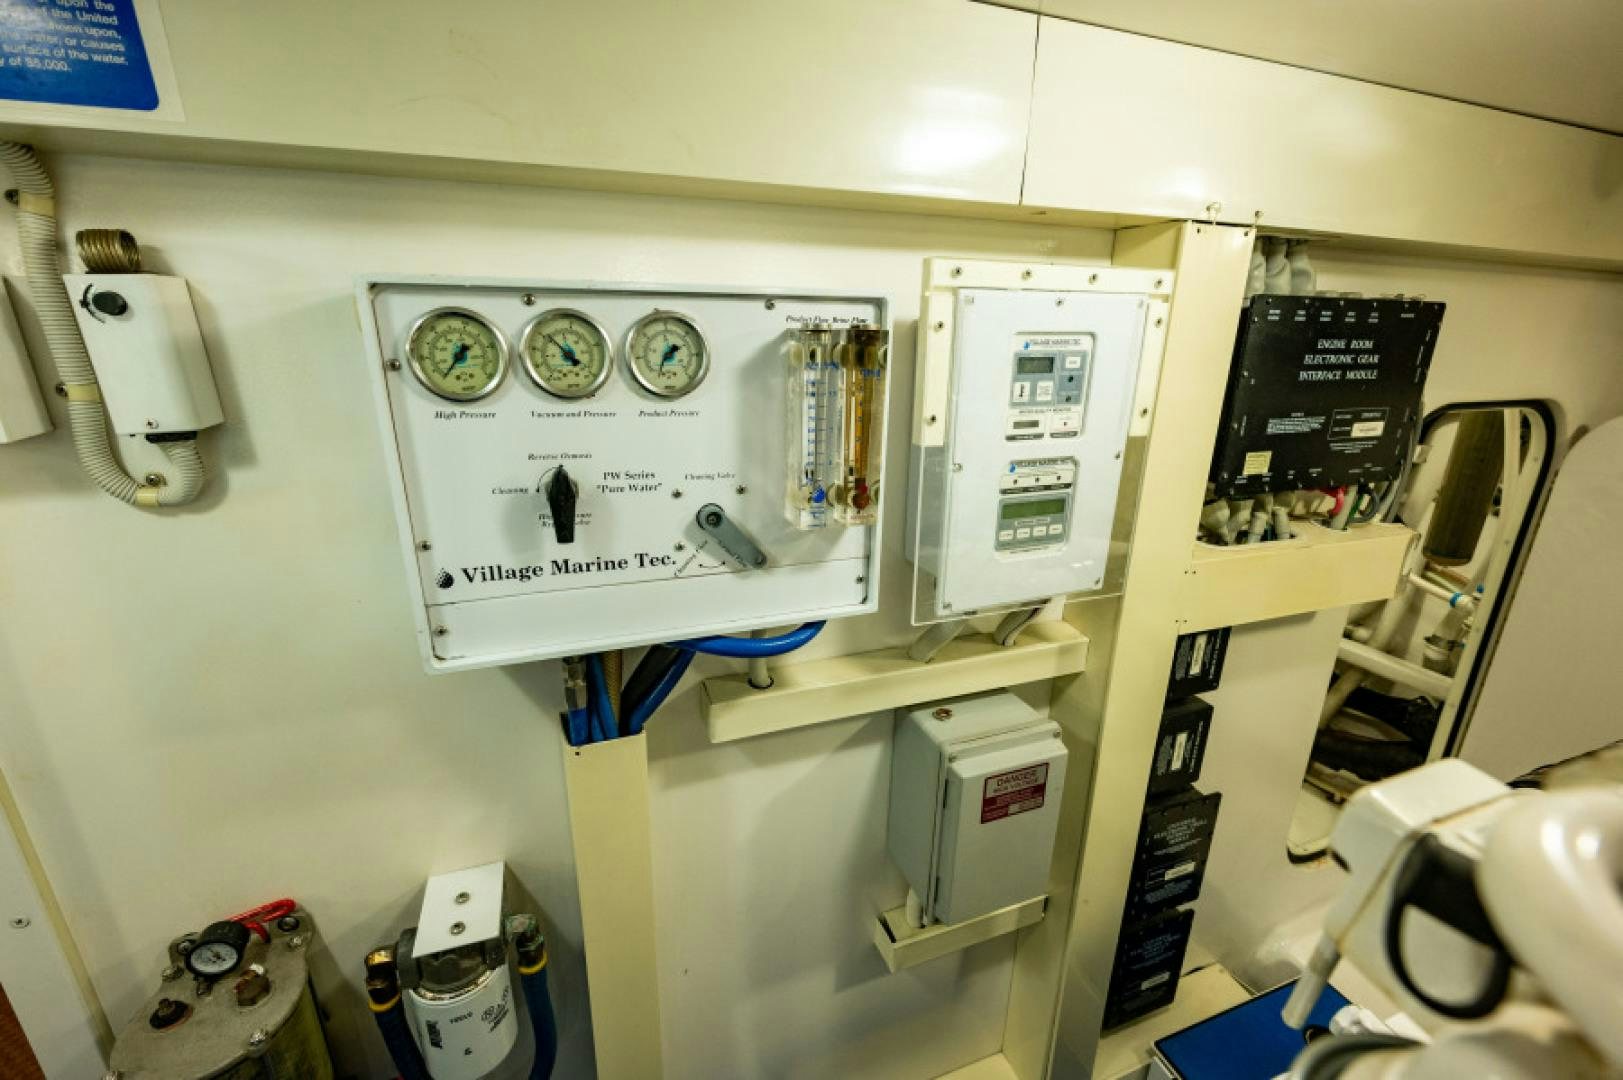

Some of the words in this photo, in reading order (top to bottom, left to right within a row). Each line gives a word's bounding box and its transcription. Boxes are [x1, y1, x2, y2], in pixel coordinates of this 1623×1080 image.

[95, 0, 115, 12] the
[77, 11, 119, 26] United
[80, 39, 126, 52] causes
[68, 49, 89, 61] the
[1317, 338, 1347, 349] ENGINE
[1350, 339, 1375, 349] ROOM
[1303, 354, 1356, 365] ELECTRONIC
[1357, 354, 1381, 364] GEAR
[1298, 371, 1342, 381] INTERFACE
[1345, 370, 1378, 380] MODULE
[433, 410, 457, 420] High
[459, 410, 497, 419] Pressure
[531, 410, 564, 418] Vacuum
[566, 410, 582, 418] and
[583, 410, 617, 418] Pressure
[638, 409, 668, 417] Product
[669, 408, 699, 417] Pressure
[528, 453, 559, 461] Reverse
[560, 452, 592, 460] Osmosis
[603, 471, 621, 481] PW
[625, 470, 656, 480] Series
[491, 486, 529, 495] Cleaning
[461, 563, 544, 584] Village
[550, 556, 629, 576] Marine
[634, 552, 677, 569] Tec.
[996, 769, 1037, 787] DANGER
